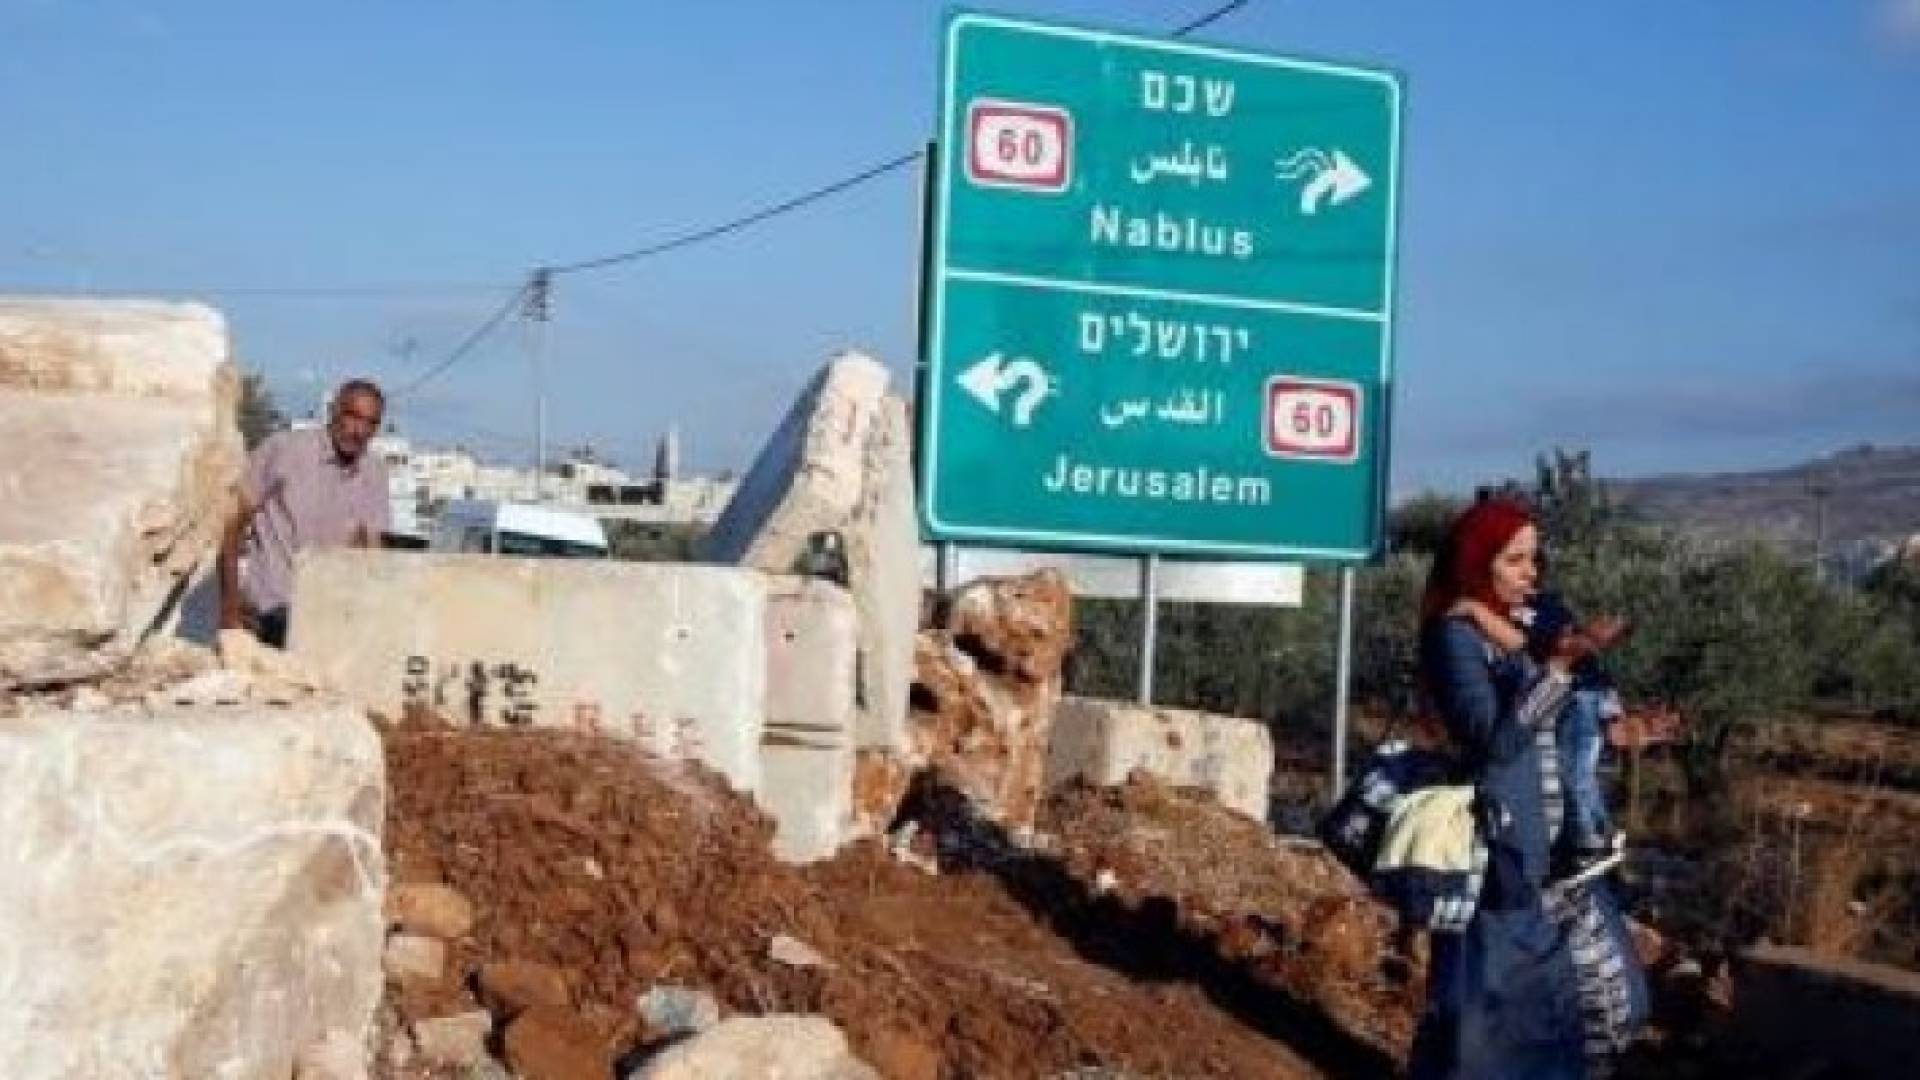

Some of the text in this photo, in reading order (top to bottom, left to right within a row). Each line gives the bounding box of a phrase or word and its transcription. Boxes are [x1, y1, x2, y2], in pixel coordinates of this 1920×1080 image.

[1140, 70, 1235, 116] שכם
[998, 129, 1044, 167] 60
[1130, 138, 1228, 188] نابلس
[1090, 203, 1254, 259] Nablus
[1079, 311, 1250, 363] ירושלים
[1100, 387, 1223, 427] القدس
[1291, 403, 1333, 437] 60
[1043, 456, 1271, 505] Jerusalem
